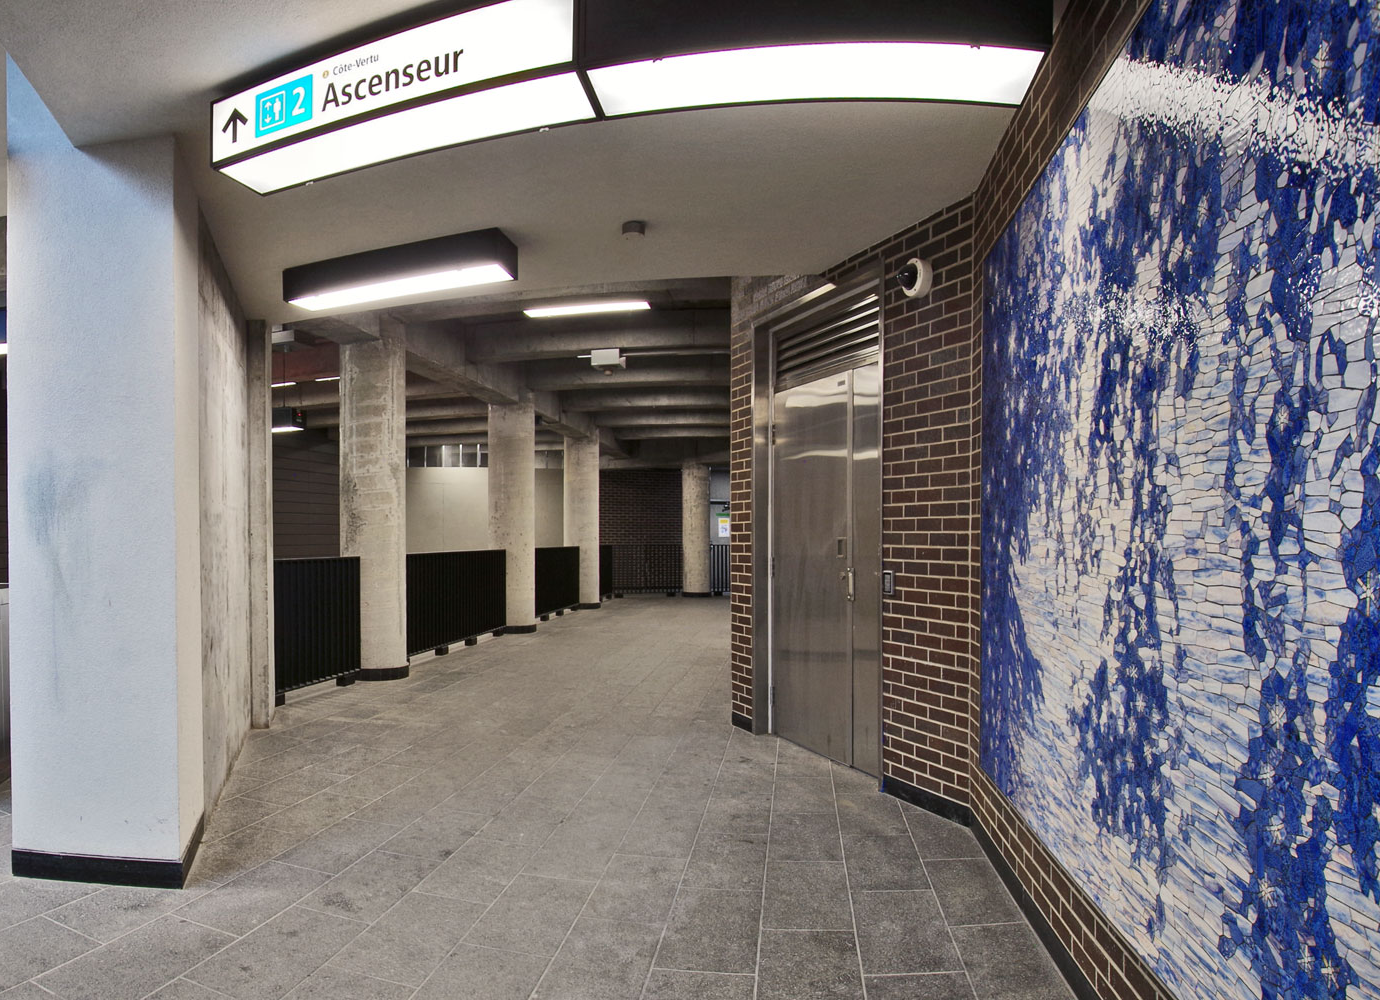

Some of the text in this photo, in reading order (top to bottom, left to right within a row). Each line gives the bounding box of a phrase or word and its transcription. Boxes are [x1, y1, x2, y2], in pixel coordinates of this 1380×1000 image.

[291, 48, 464, 117] 2 Ascenseur
[332, 54, 379, 76] Côte-Vertu
